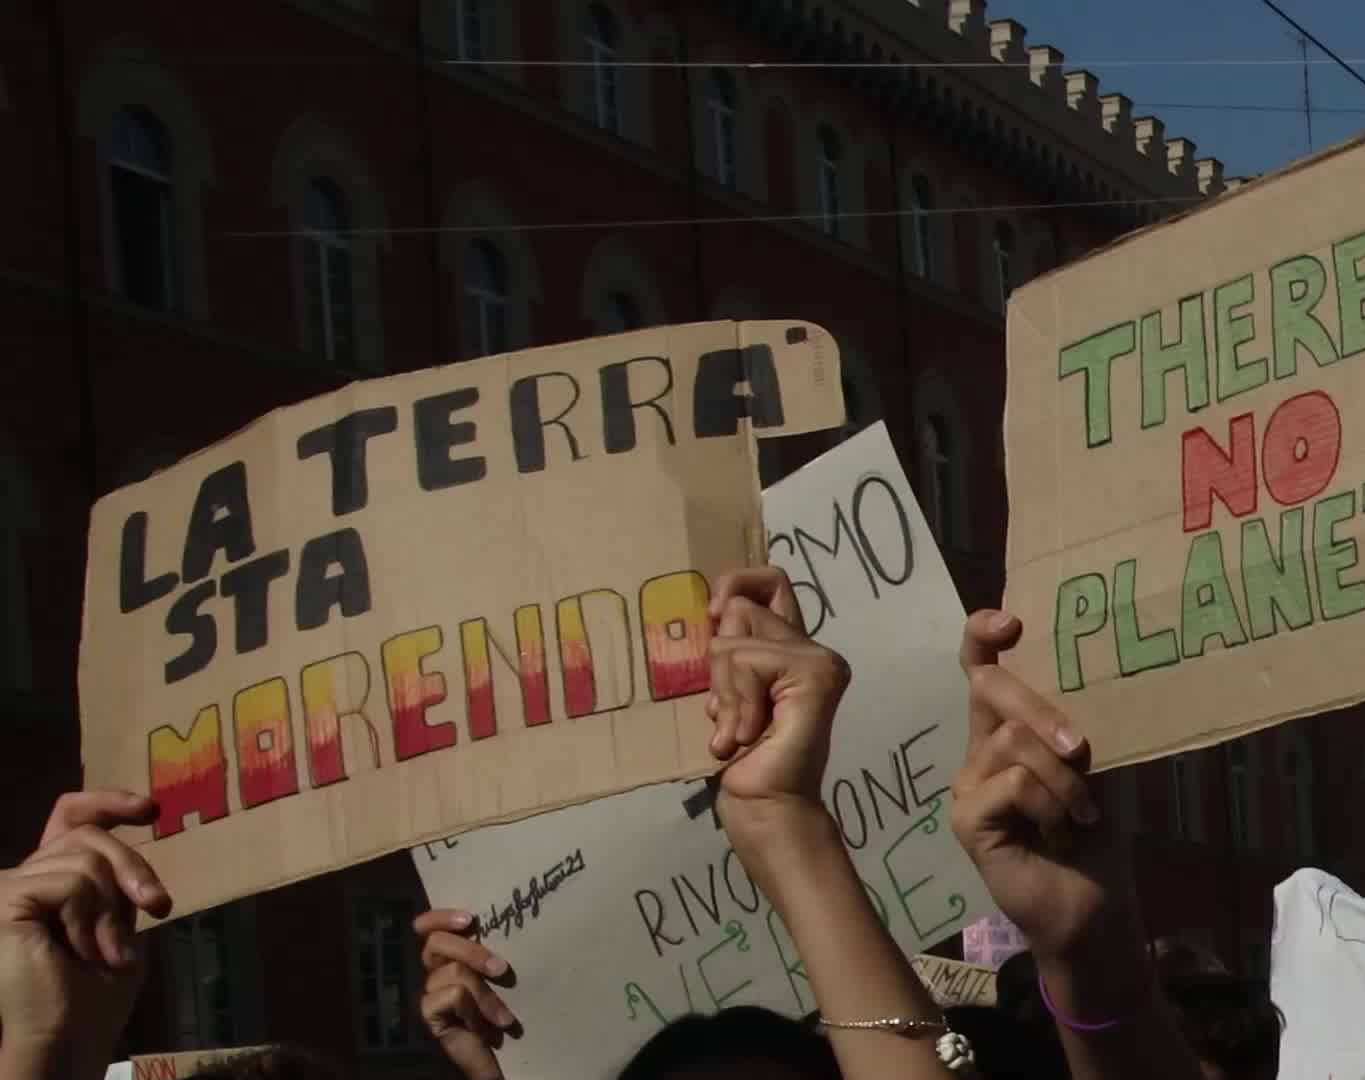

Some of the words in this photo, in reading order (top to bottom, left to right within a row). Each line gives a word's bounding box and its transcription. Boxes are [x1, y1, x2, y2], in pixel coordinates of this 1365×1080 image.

[119, 461, 254, 614] LA
[1181, 390, 1341, 533] NO
[164, 528, 372, 685] STA
[147, 570, 711, 840] MORENDO
